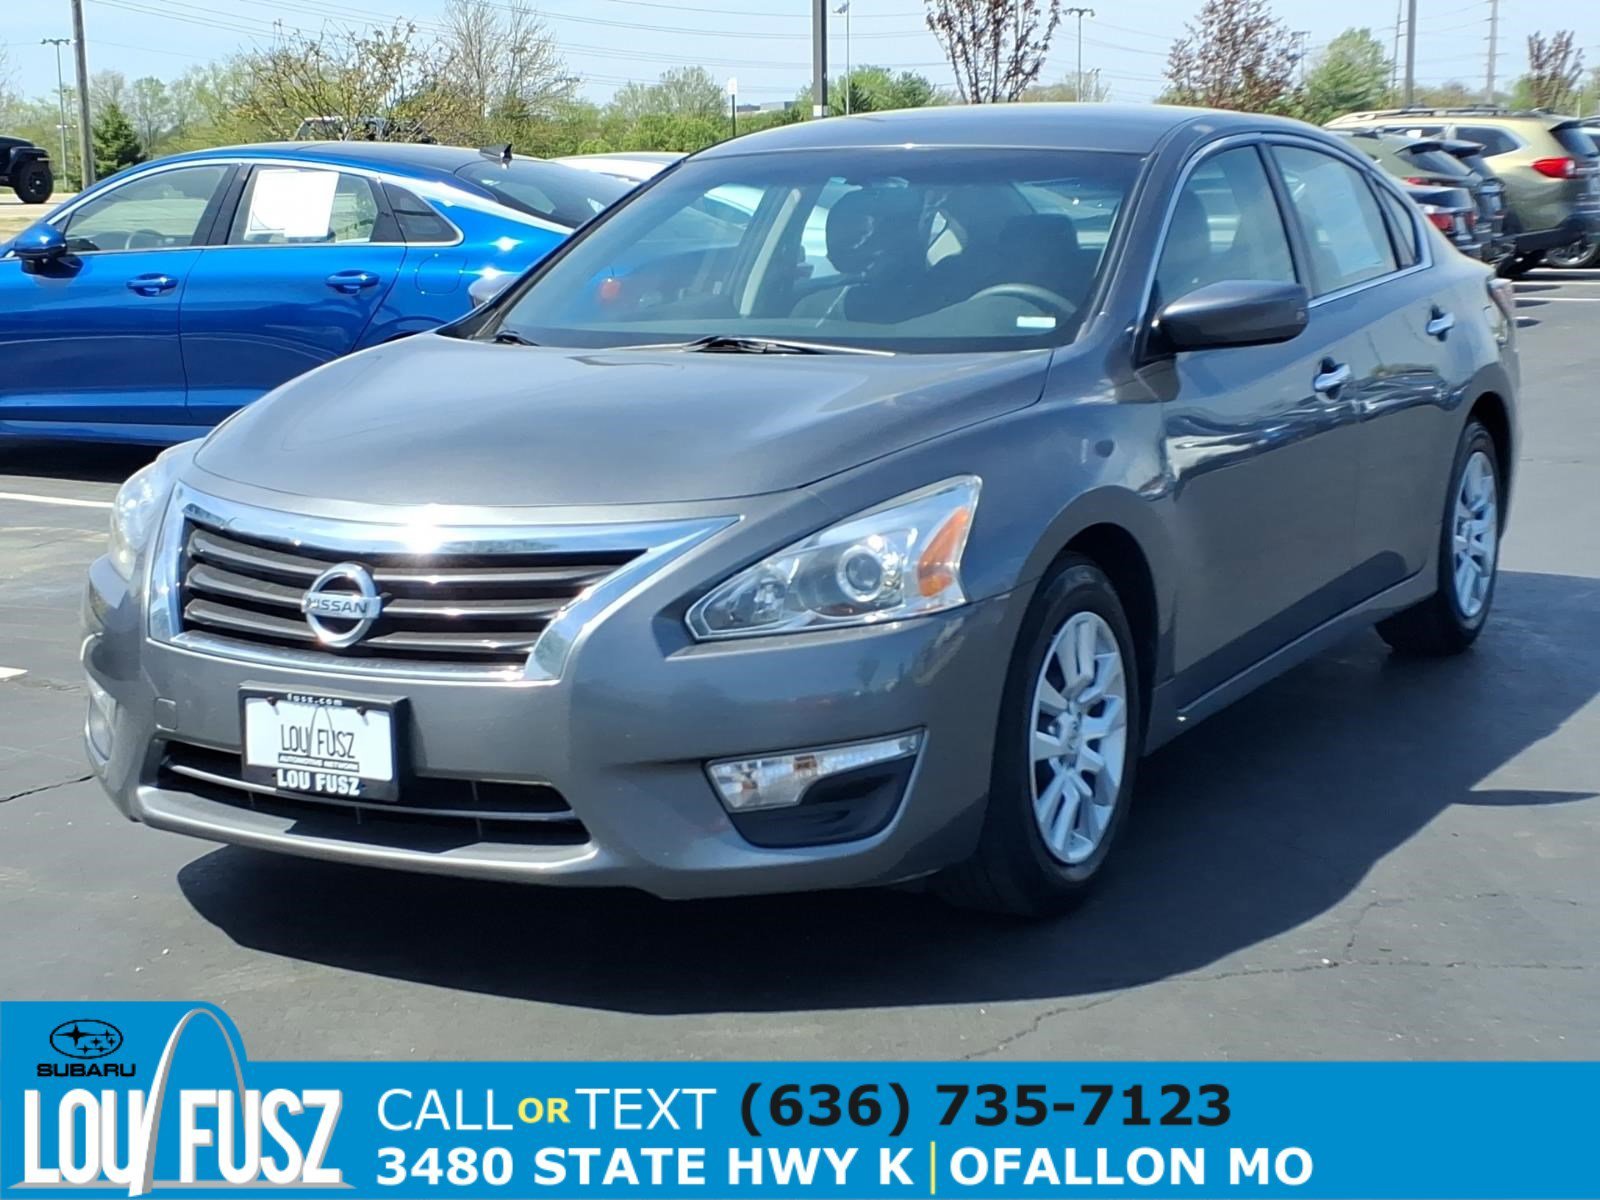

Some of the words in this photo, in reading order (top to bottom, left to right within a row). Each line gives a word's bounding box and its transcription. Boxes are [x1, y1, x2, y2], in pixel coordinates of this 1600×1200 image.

[306, 597, 368, 614] NISSAN
[287, 692, 343, 706] fusz.com
[280, 724, 310, 753] LOU
[317, 728, 356, 759] FUSZ
[276, 768, 310, 790] LOU
[315, 773, 361, 797] FUSZ
